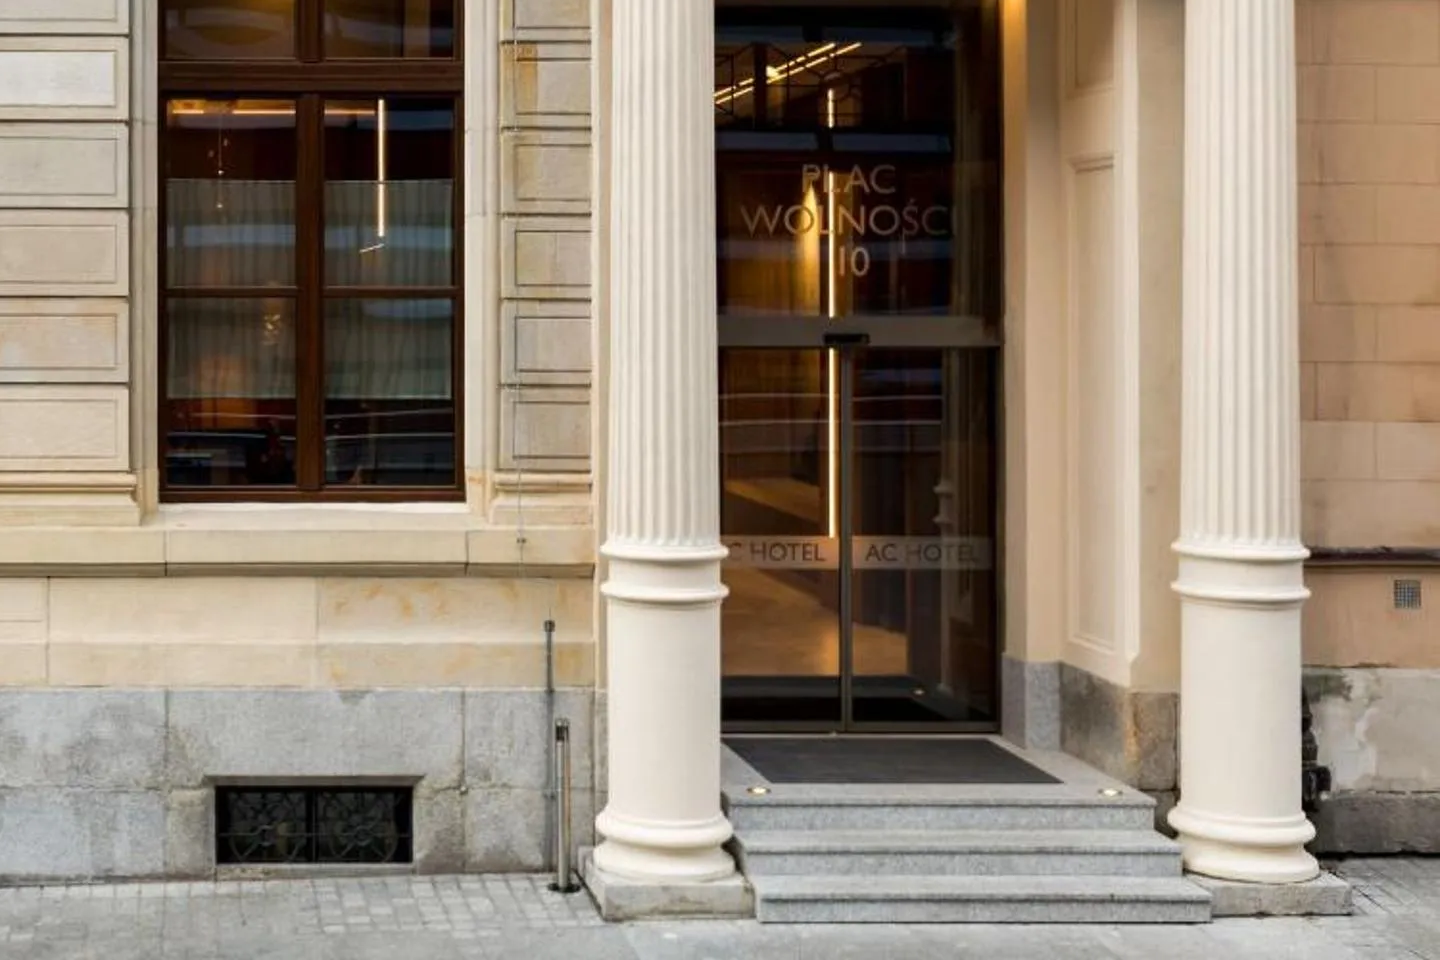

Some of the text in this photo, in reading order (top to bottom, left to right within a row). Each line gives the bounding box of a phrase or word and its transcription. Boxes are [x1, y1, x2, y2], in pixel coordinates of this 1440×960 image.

[801, 163, 897, 194] PLAC
[839, 247, 870, 277] 10
[726, 541, 827, 562] C HOTEL
[864, 543, 980, 562] AC HOTEL
